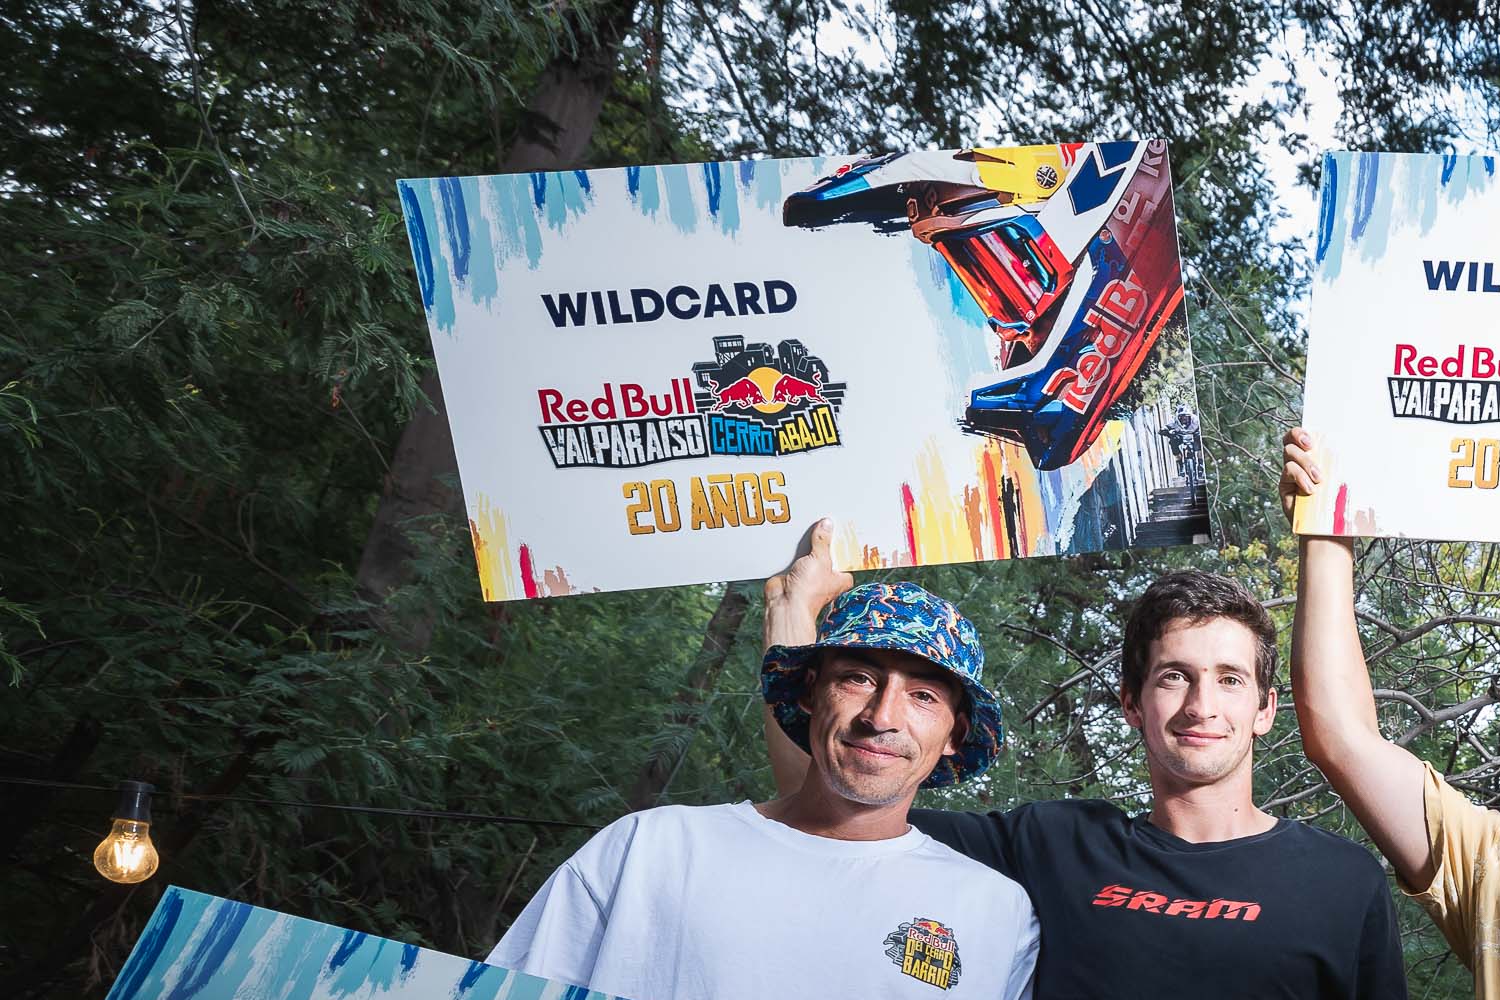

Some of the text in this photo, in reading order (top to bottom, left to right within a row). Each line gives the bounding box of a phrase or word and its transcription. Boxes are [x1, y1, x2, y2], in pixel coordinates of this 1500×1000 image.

[541, 280, 797, 327] WILDCARD
[1393, 344, 1465, 377] Red
[537, 377, 696, 424] Red Bull
[544, 407, 837, 465] VALPARAISO CERRO ABAJO
[1448, 437, 1500, 490] 20
[622, 471, 791, 535] 20 AÑOS
[1092, 884, 1261, 921] SRAM
[908, 928, 955, 951] Red Bull
[903, 956, 949, 988] BARRIO
